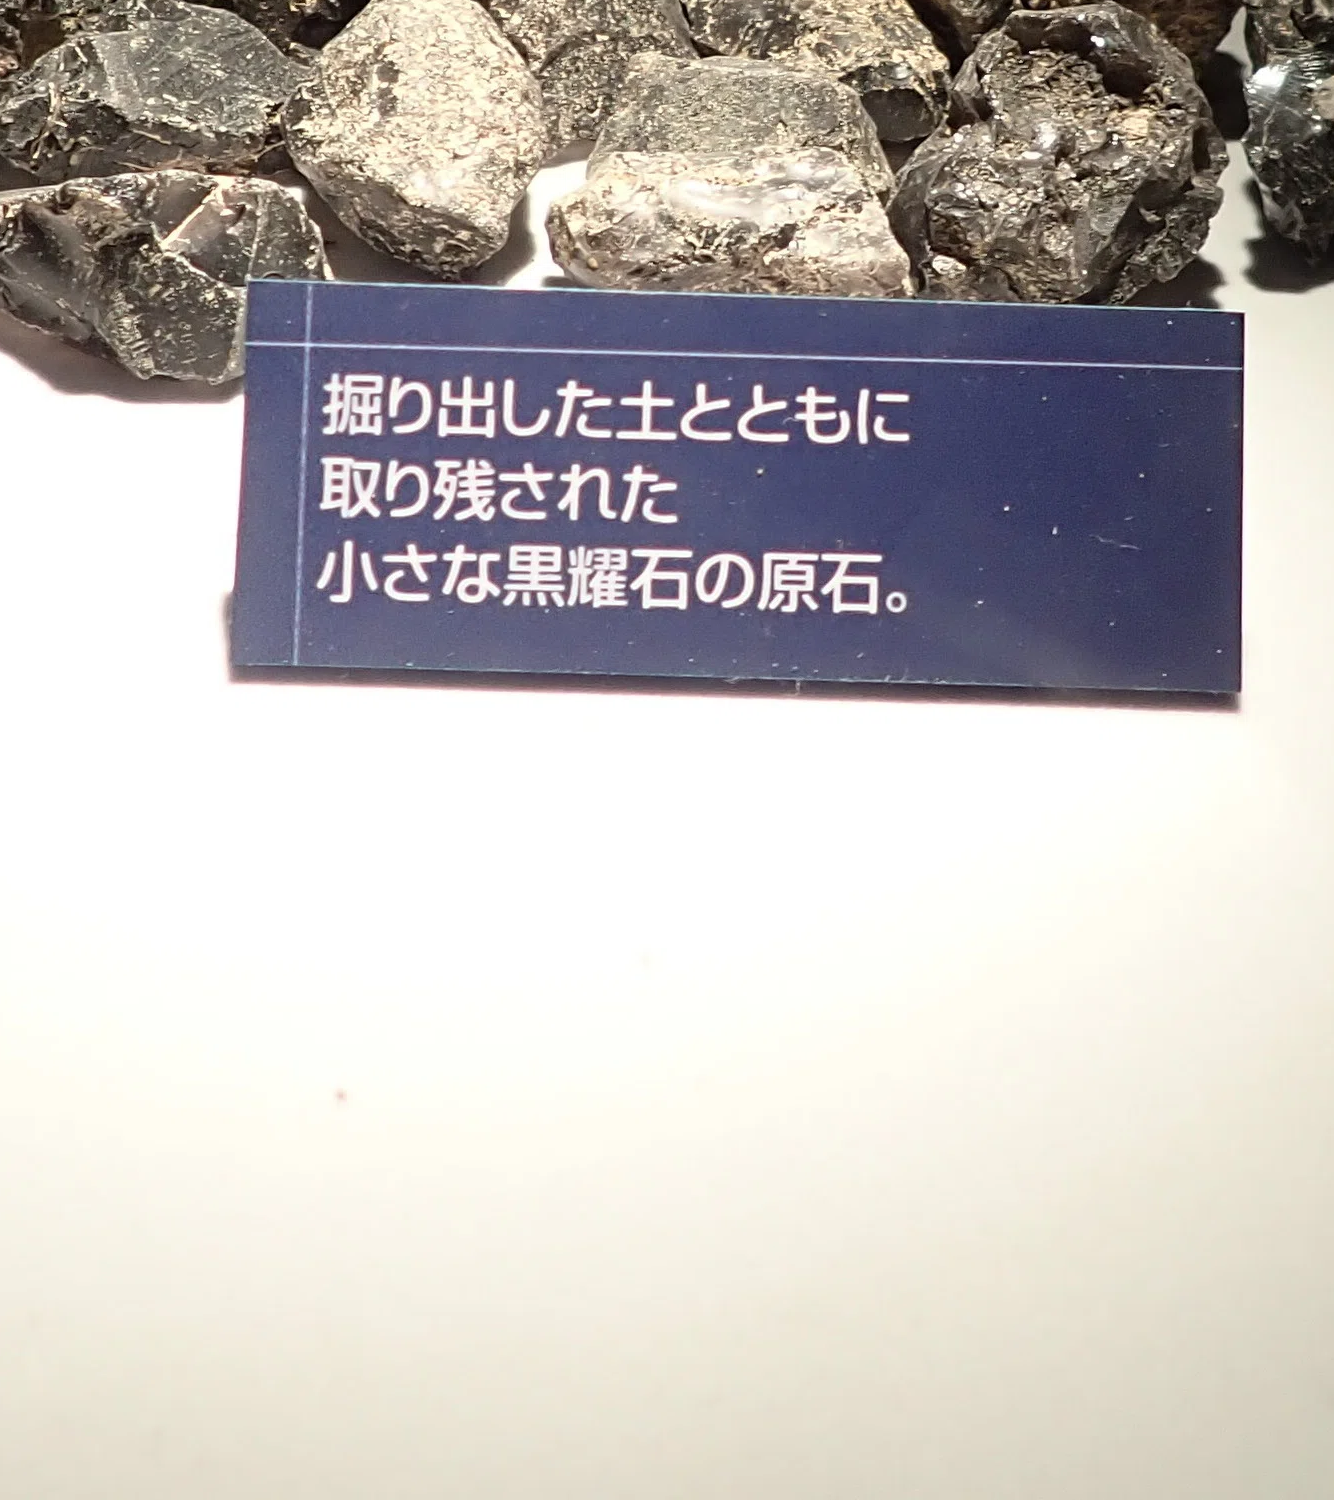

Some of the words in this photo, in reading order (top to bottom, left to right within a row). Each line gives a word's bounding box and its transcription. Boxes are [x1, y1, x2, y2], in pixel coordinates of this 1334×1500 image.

[321, 373, 911, 446] 掘り出した土とともに
[318, 455, 679, 525] 取り残された
[315, 540, 908, 615] 小さな黒耀石の原石。
